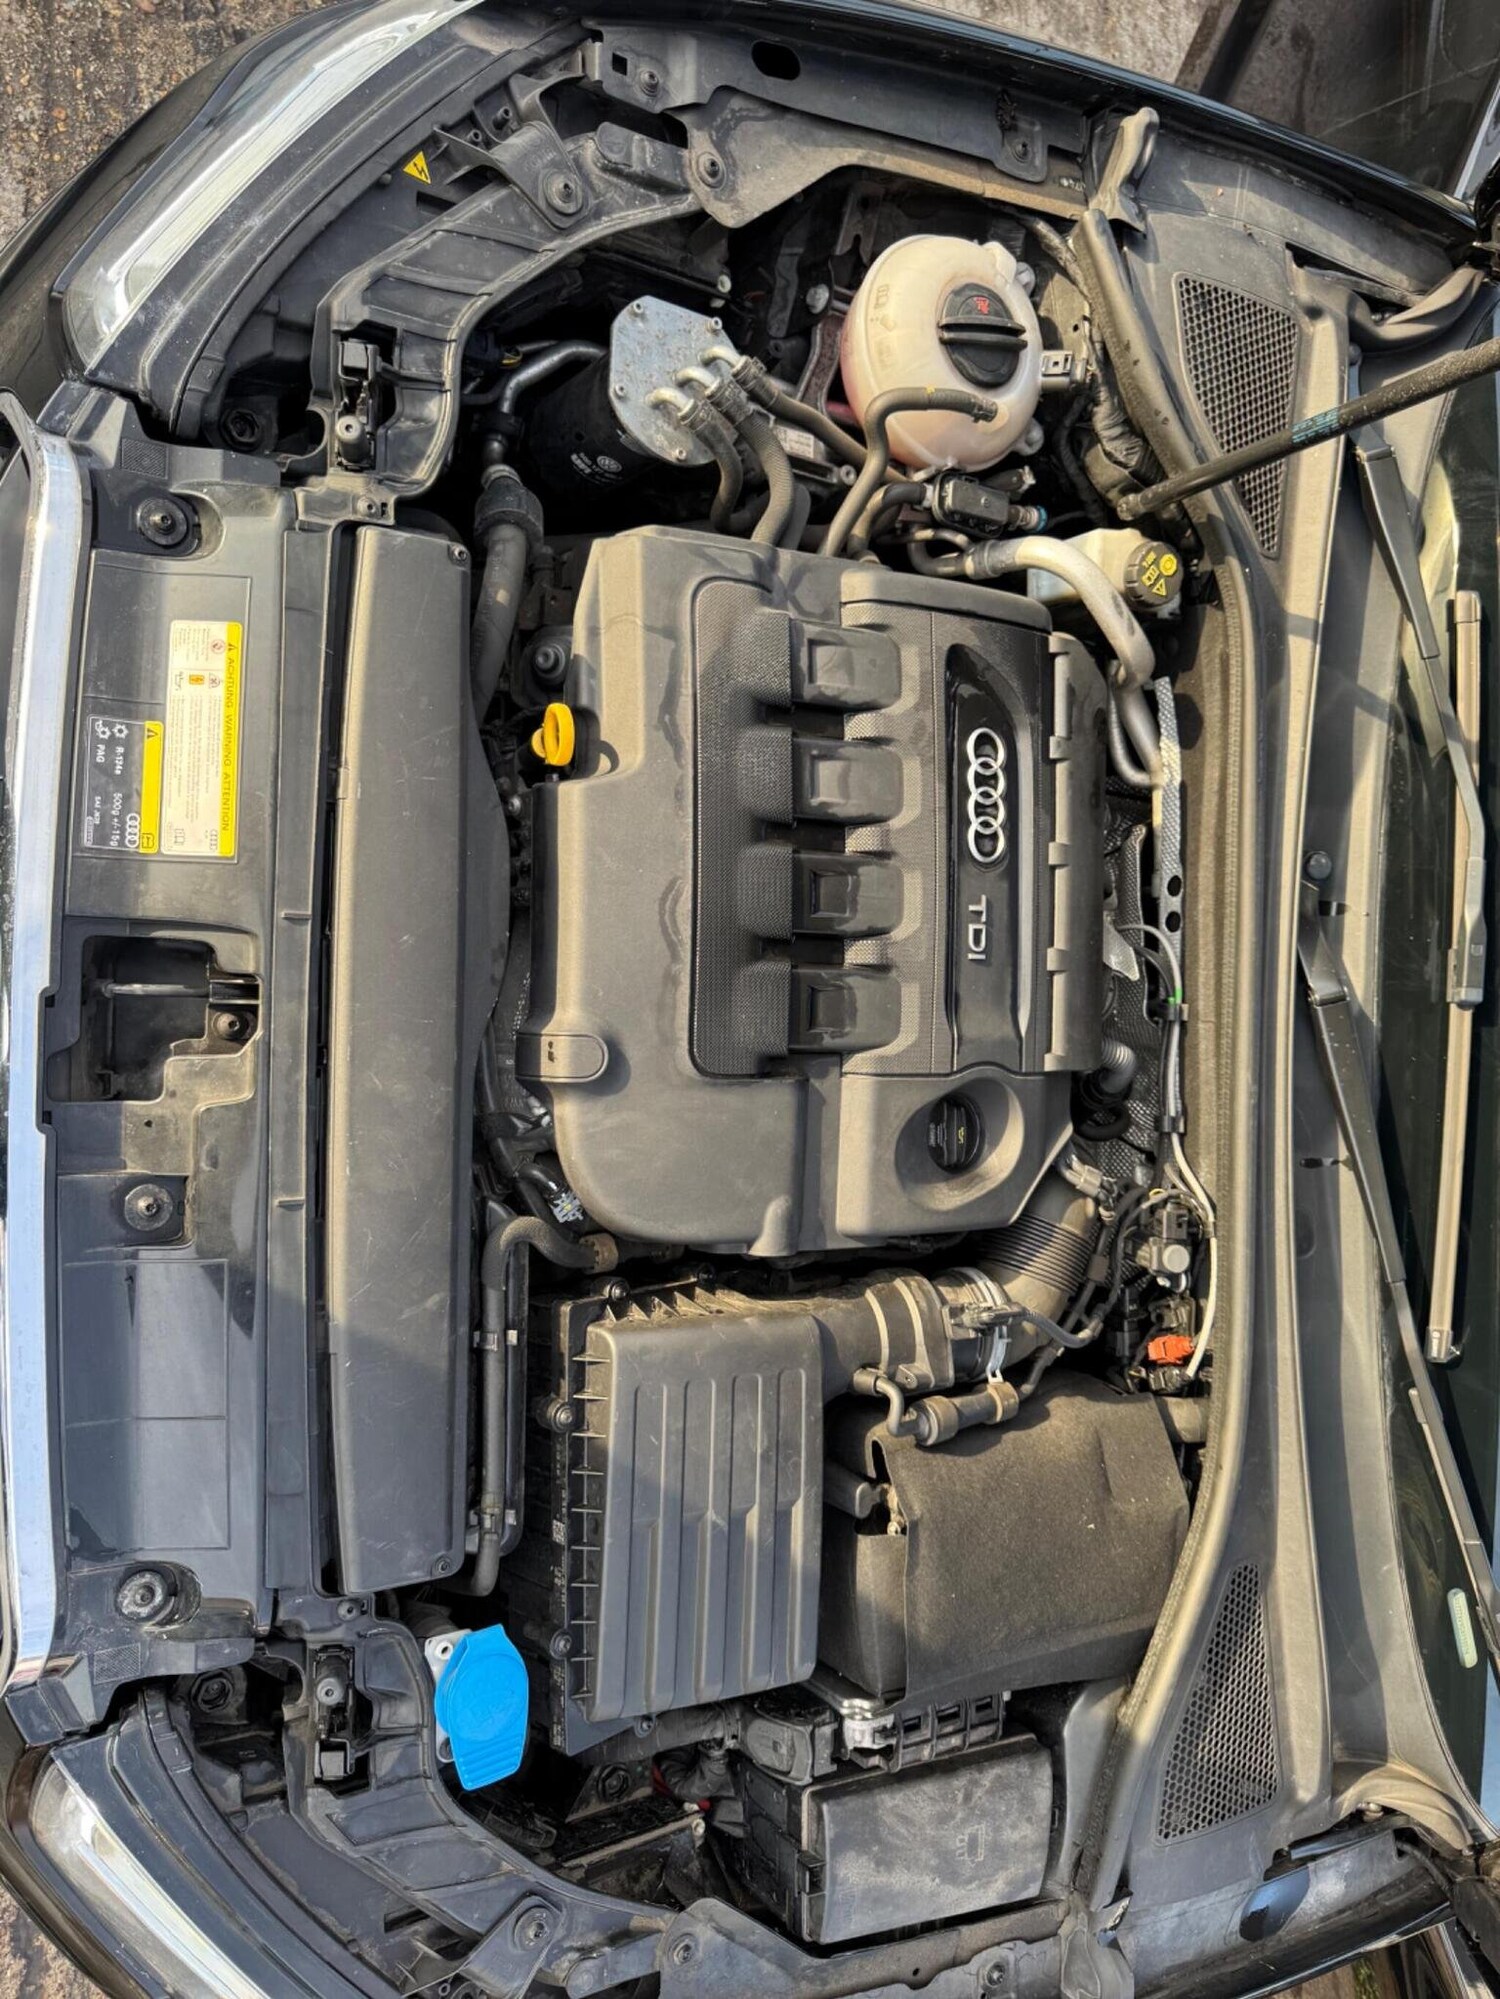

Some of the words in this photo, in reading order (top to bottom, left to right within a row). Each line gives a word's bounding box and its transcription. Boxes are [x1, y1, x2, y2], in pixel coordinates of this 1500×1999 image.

[225, 657, 235, 710] ACHTUNG
[96, 744, 106, 763] PAG
[223, 714, 234, 767] WARNING
[112, 792, 124, 817] 500g
[221, 772, 232, 832] ATTENTION
[967, 894, 986, 960] TDI
